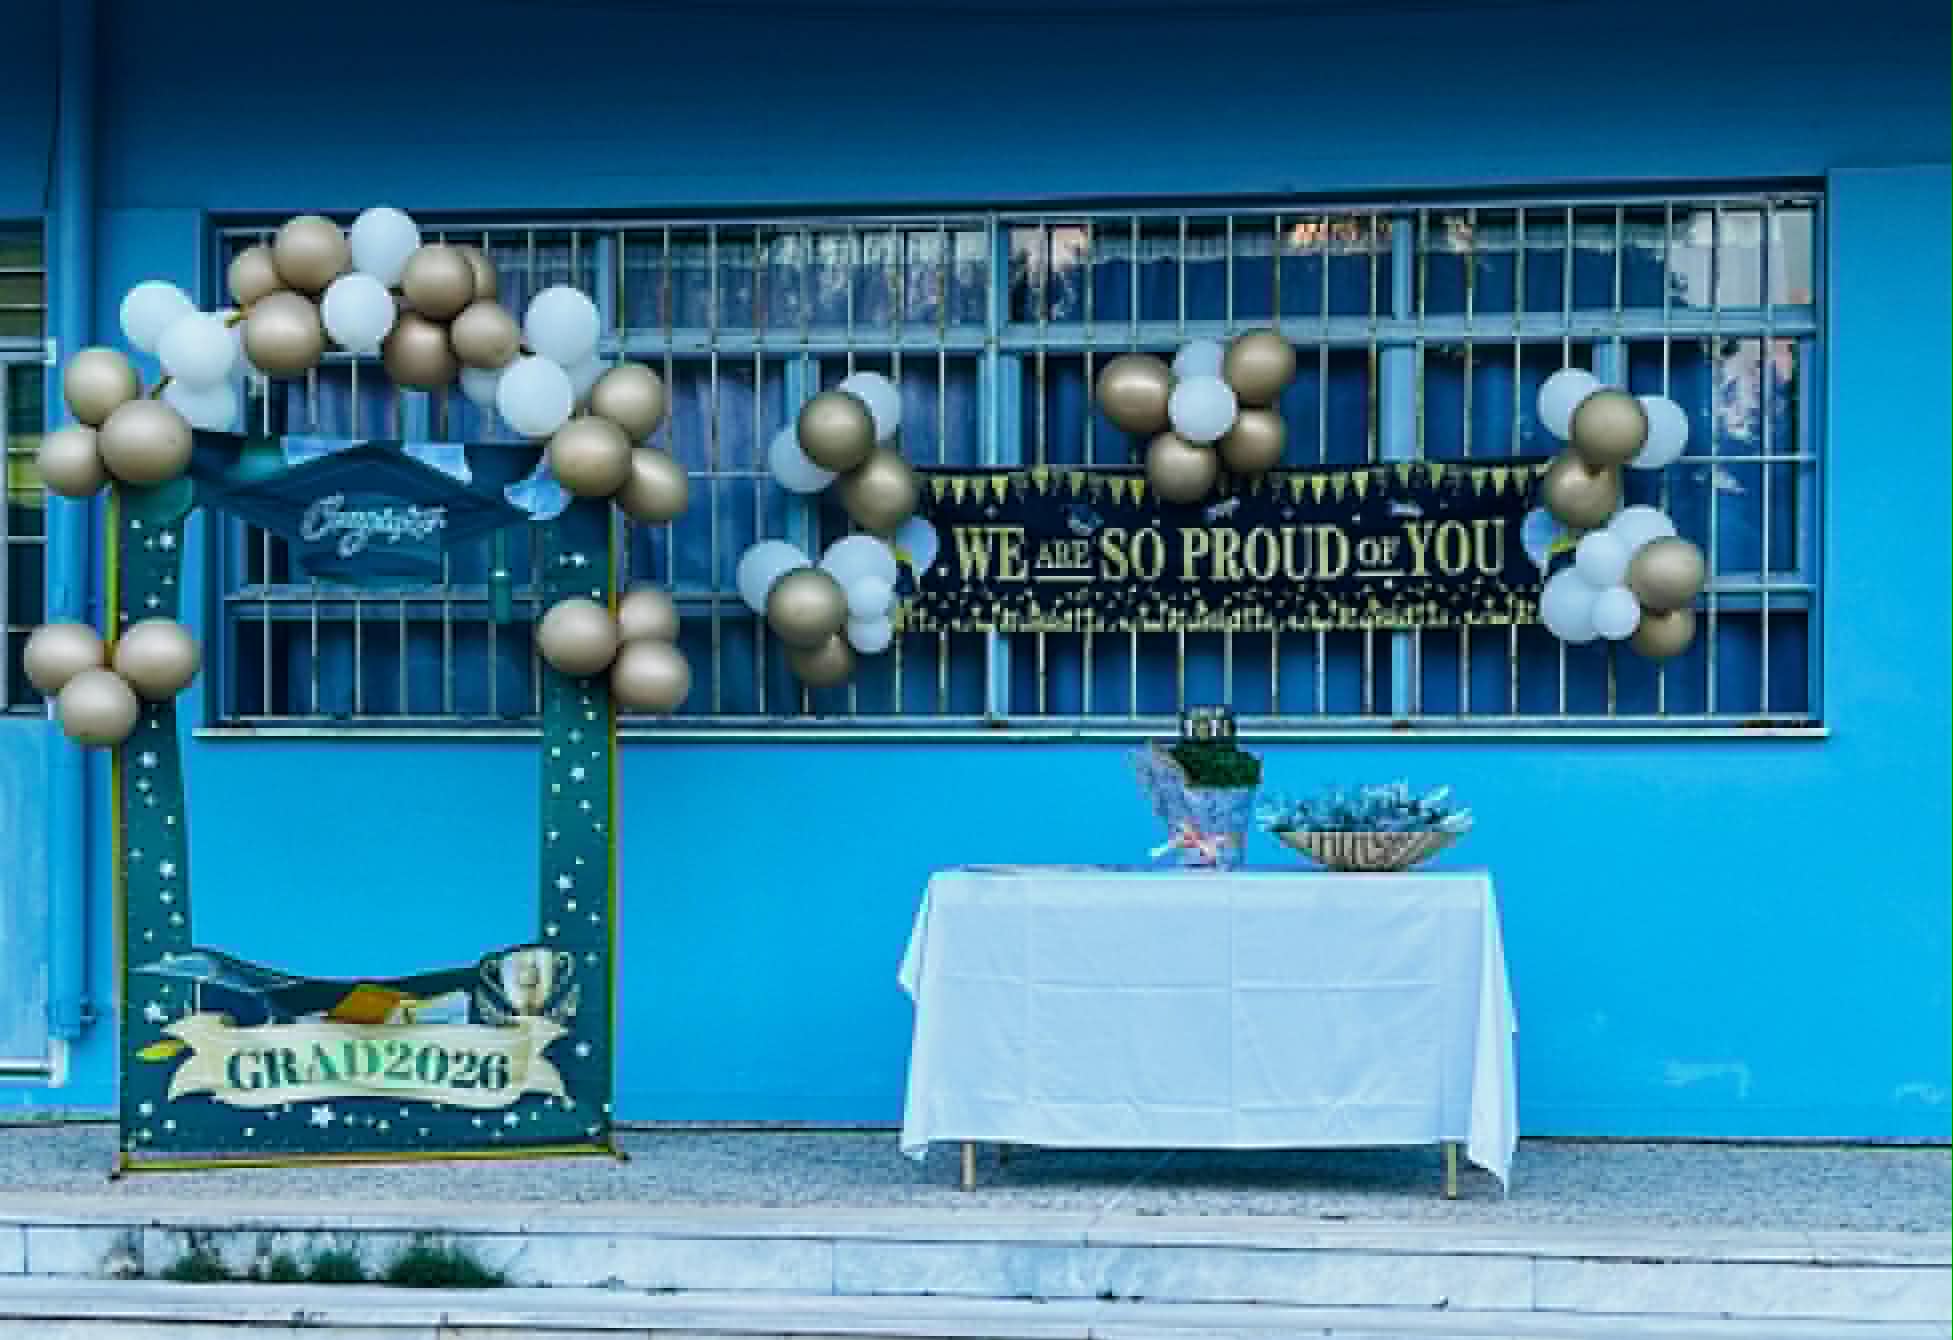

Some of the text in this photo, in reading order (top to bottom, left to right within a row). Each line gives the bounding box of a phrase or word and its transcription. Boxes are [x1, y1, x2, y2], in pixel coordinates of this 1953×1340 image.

[952, 519, 1506, 580] WE ARE SO PROUD OF YOU
